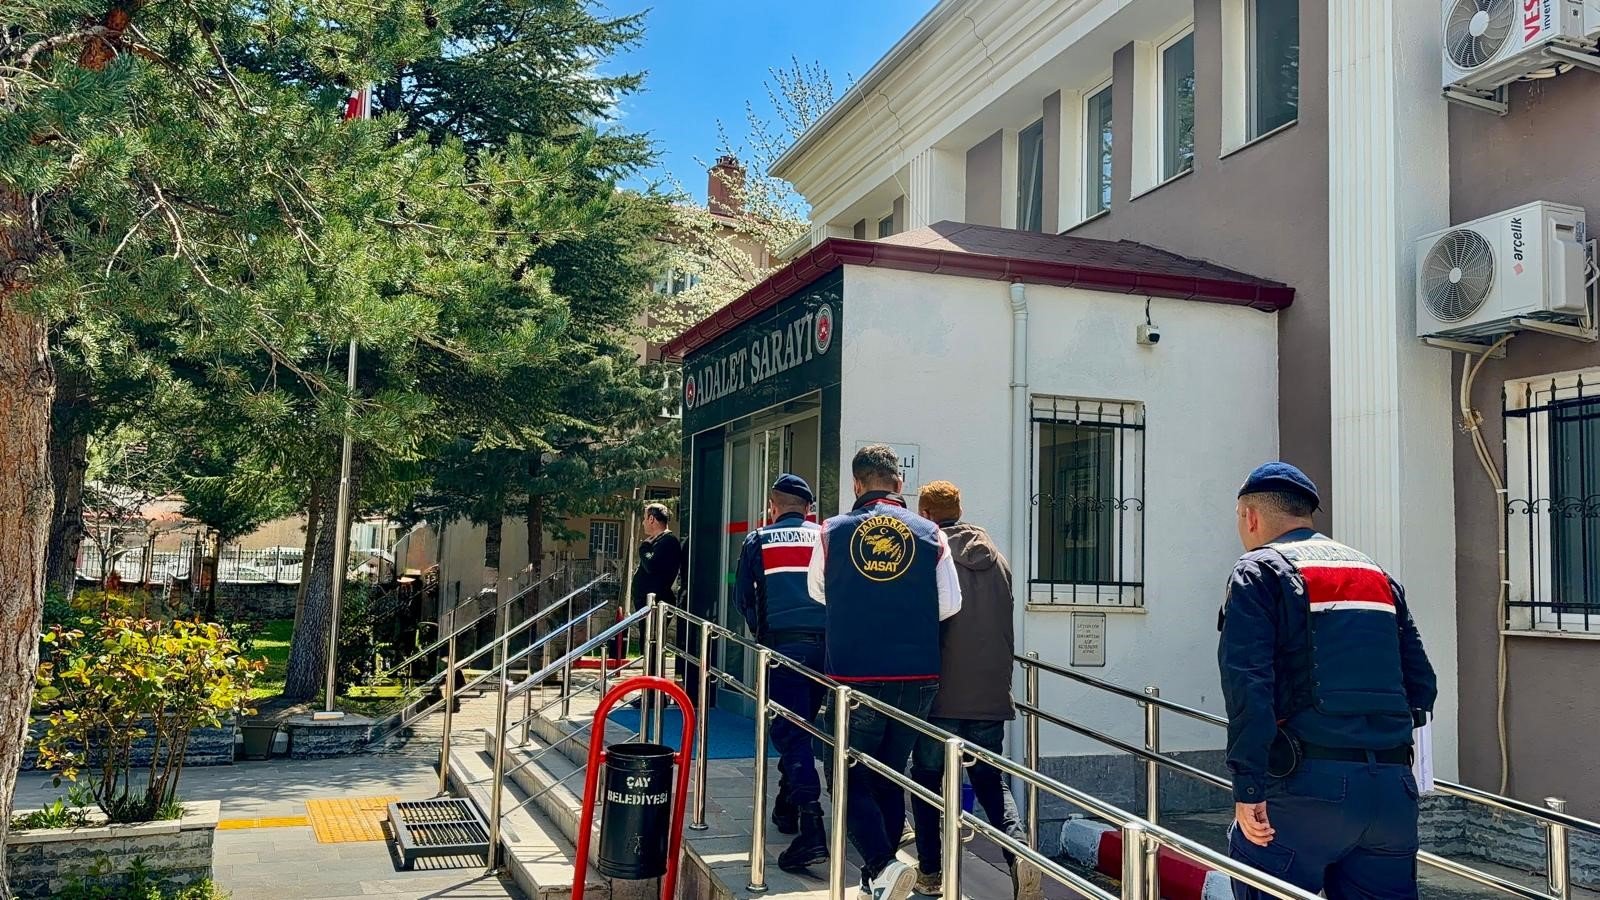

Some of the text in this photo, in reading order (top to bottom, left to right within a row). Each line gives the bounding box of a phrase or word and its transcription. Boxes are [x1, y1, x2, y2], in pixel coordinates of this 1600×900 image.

[1511, 217, 1525, 261] arçelik
[695, 347, 748, 408] ADALET
[858, 517, 910, 541] JANDARMA
[863, 560, 898, 572] JASAT
[626, 776, 651, 789] ÇAY
